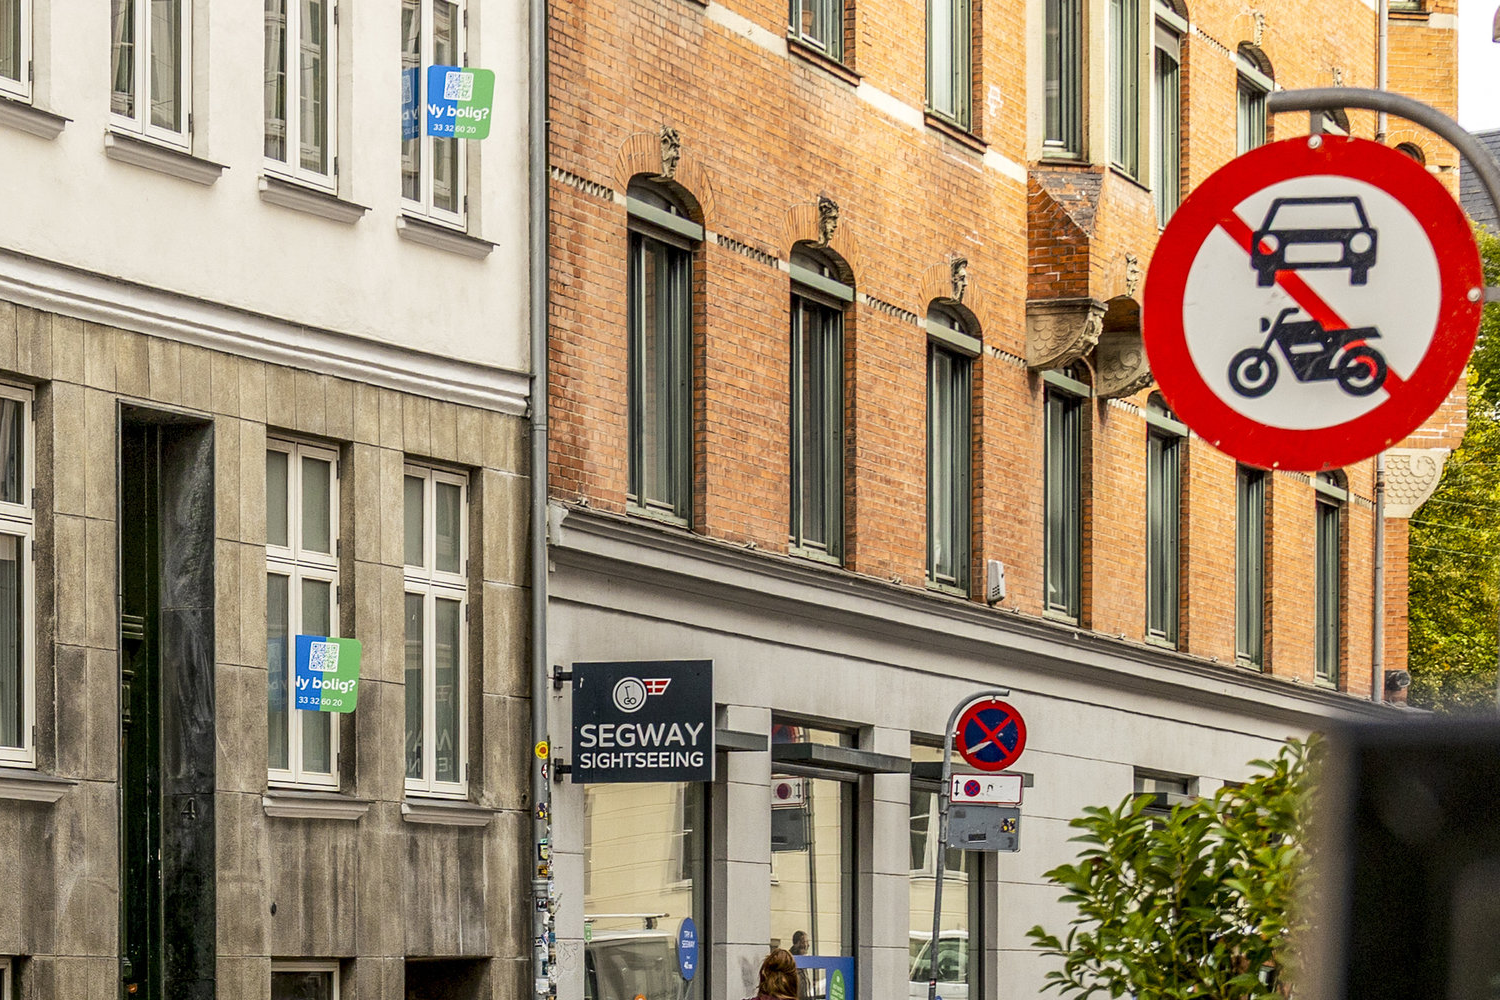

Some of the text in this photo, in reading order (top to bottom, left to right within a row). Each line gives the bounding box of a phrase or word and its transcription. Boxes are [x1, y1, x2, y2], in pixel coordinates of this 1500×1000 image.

[447, 105, 489, 121] bolig?
[444, 124, 454, 132] 32
[455, 125, 465, 133] 60
[312, 677, 356, 694] bolig?
[298, 696, 308, 704] 33
[310, 697, 320, 705] 32
[580, 722, 704, 748] SEGWAY
[580, 752, 704, 769] SIGHTSEEING
[181, 797, 196, 820] 4
